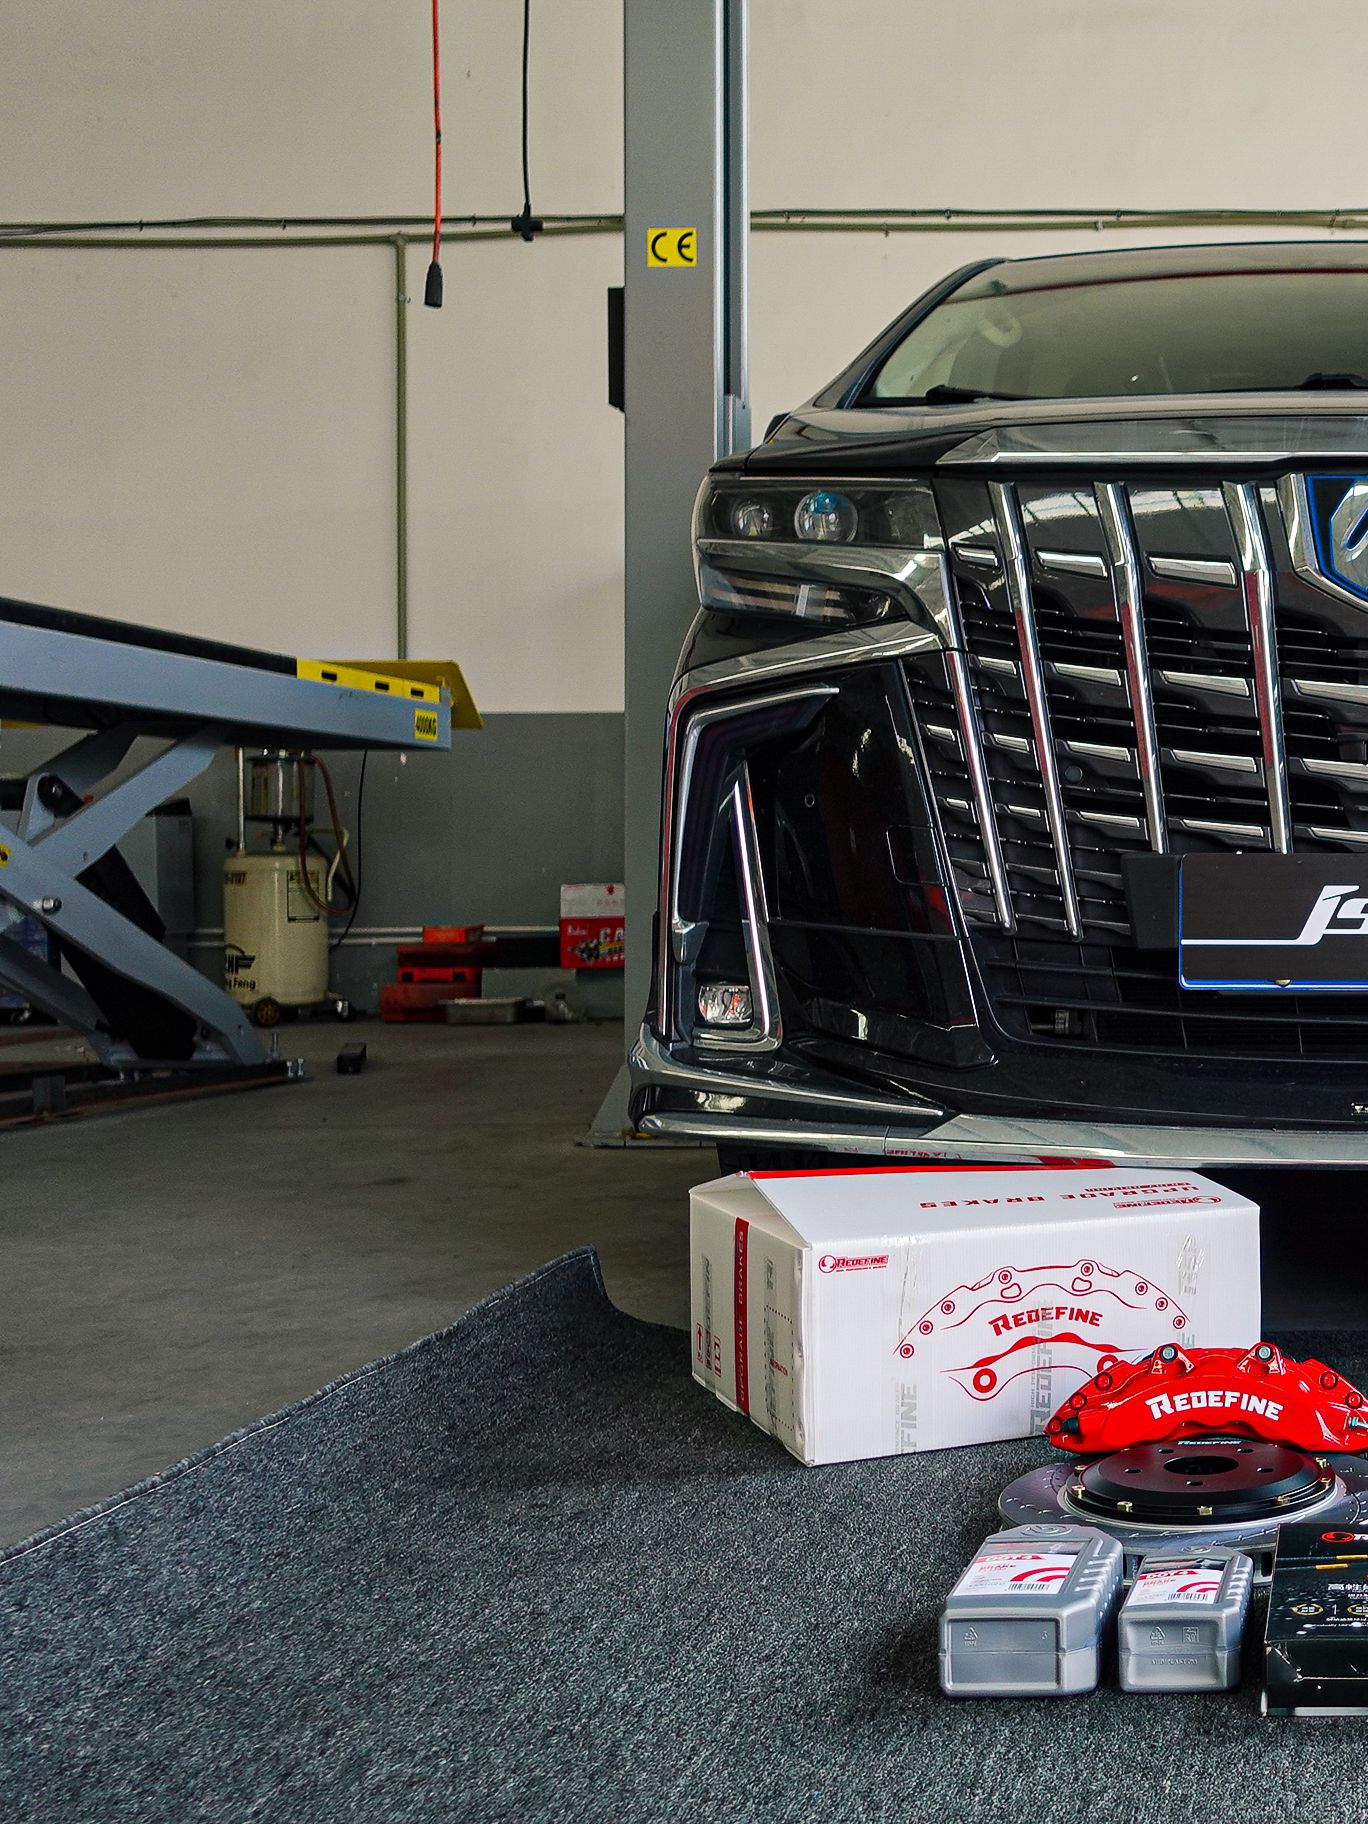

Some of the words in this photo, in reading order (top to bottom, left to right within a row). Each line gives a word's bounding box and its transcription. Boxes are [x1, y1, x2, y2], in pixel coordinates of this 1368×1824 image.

[651, 231, 694, 263] CE
[919, 1194, 1046, 1209] BRAKES
[836, 1255, 889, 1267] REDEFINE
[988, 1306, 1104, 1337] REDEFINE
[901, 1384, 917, 1454] FINE
[1145, 1390, 1284, 1421] REDEFINE
